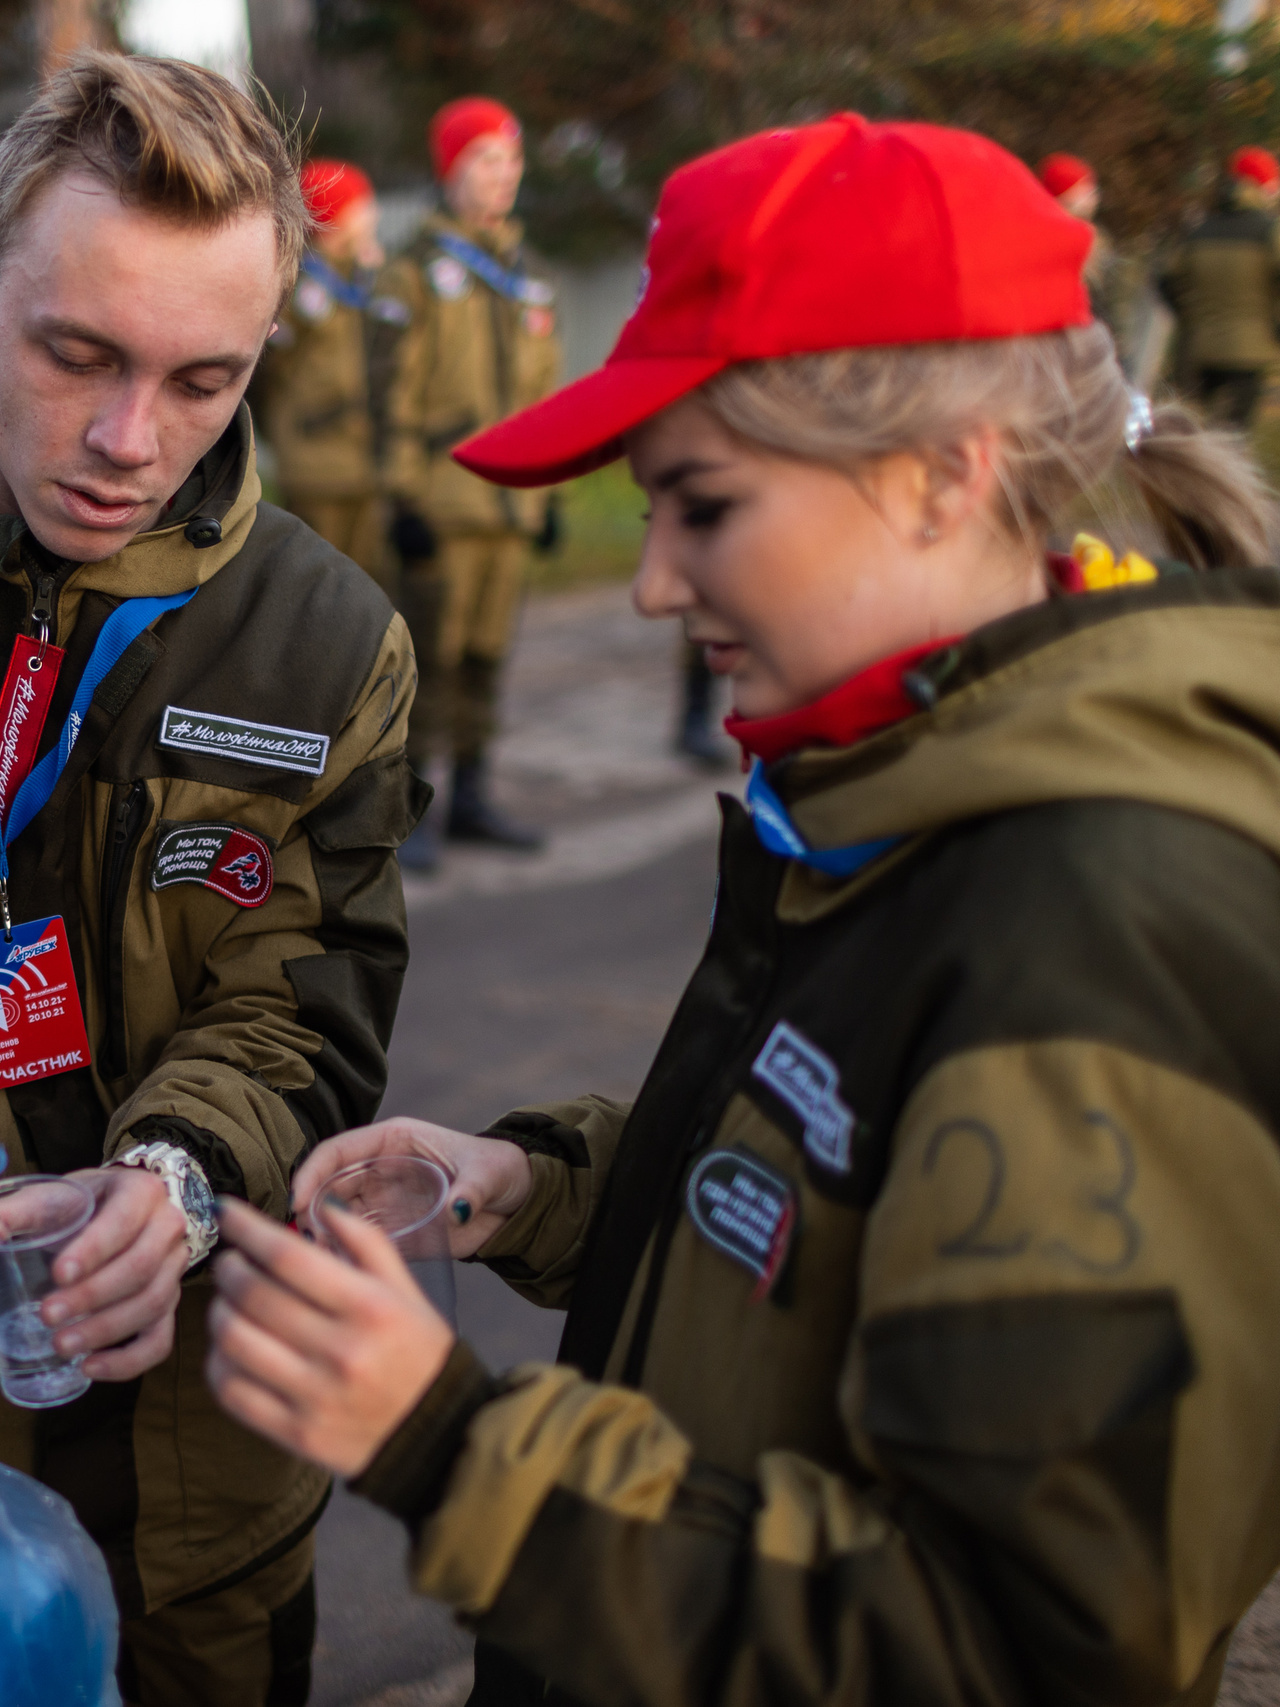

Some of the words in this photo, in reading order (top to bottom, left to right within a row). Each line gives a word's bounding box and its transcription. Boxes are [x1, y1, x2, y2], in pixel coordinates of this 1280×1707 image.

[176, 838, 196, 849] Мы
[174, 849, 214, 862] нужна
[162, 859, 208, 875] помощь
[923, 1111, 1141, 1276] 23
